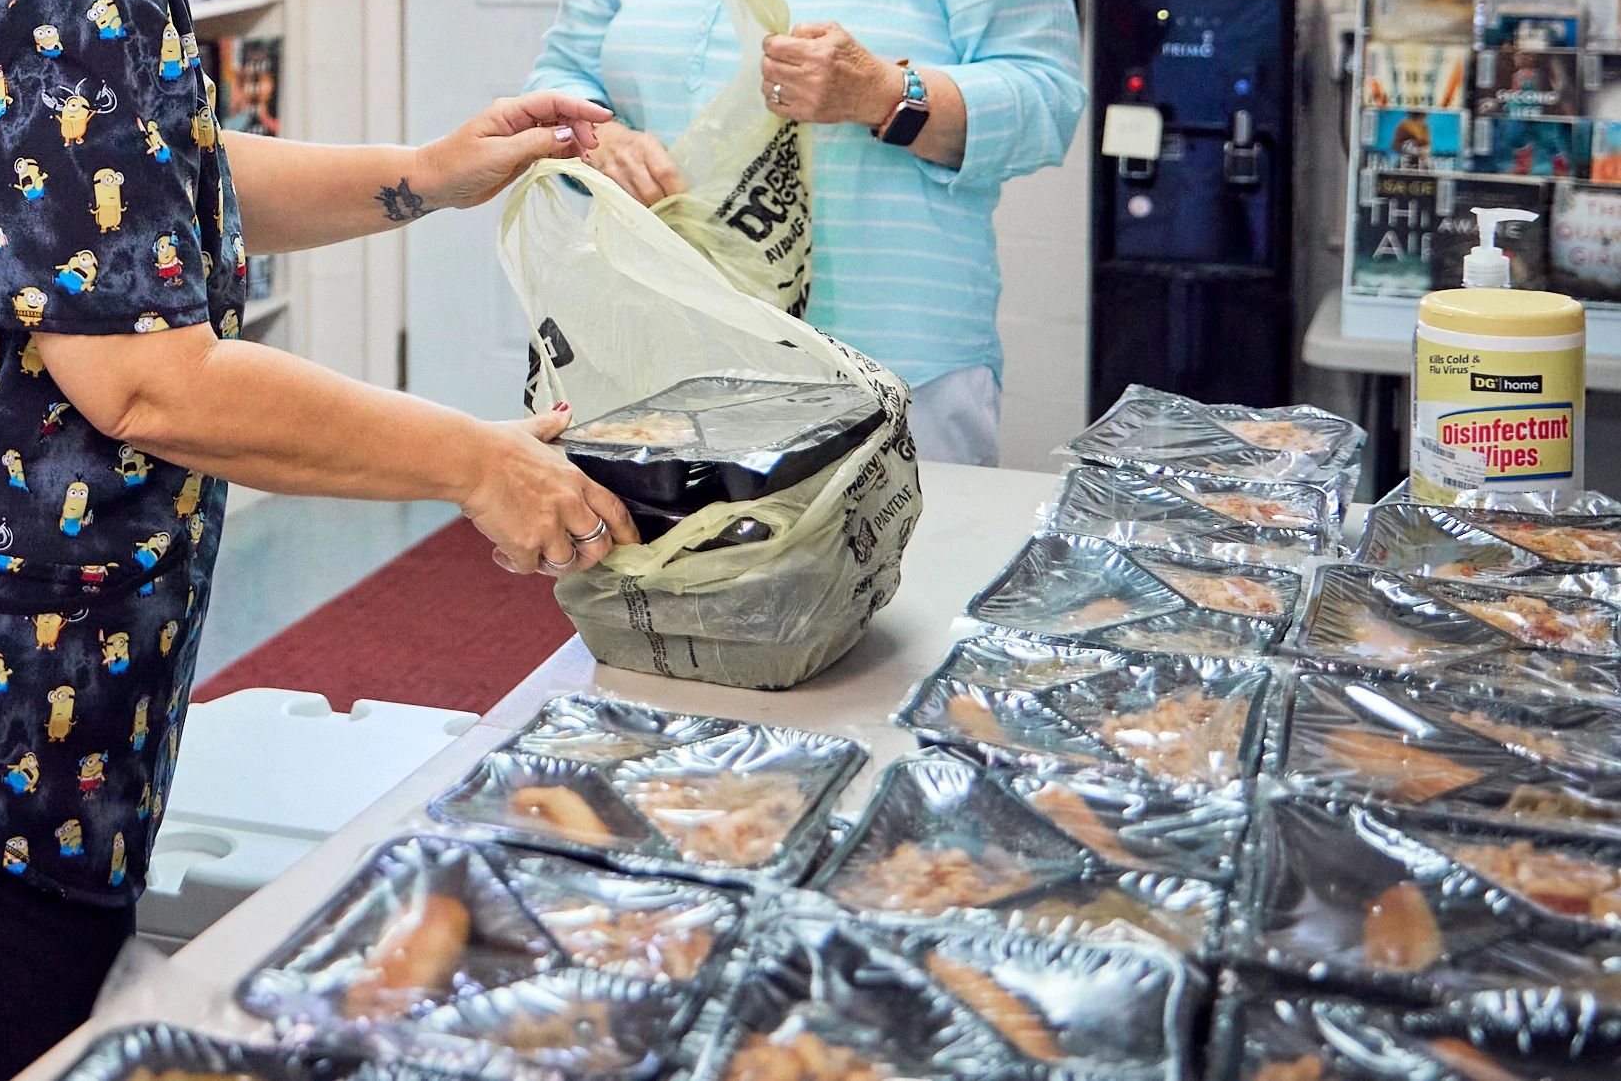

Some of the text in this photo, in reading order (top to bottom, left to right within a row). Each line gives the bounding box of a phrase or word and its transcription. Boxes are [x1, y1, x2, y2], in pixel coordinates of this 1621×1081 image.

[1429, 355, 1480, 364] Kills Cold &
[1429, 366, 1441, 374] Flu
[1474, 377, 1539, 390] DG home
[1442, 414, 1568, 445] Disinfectant
[873, 484, 914, 531] PANTENE
